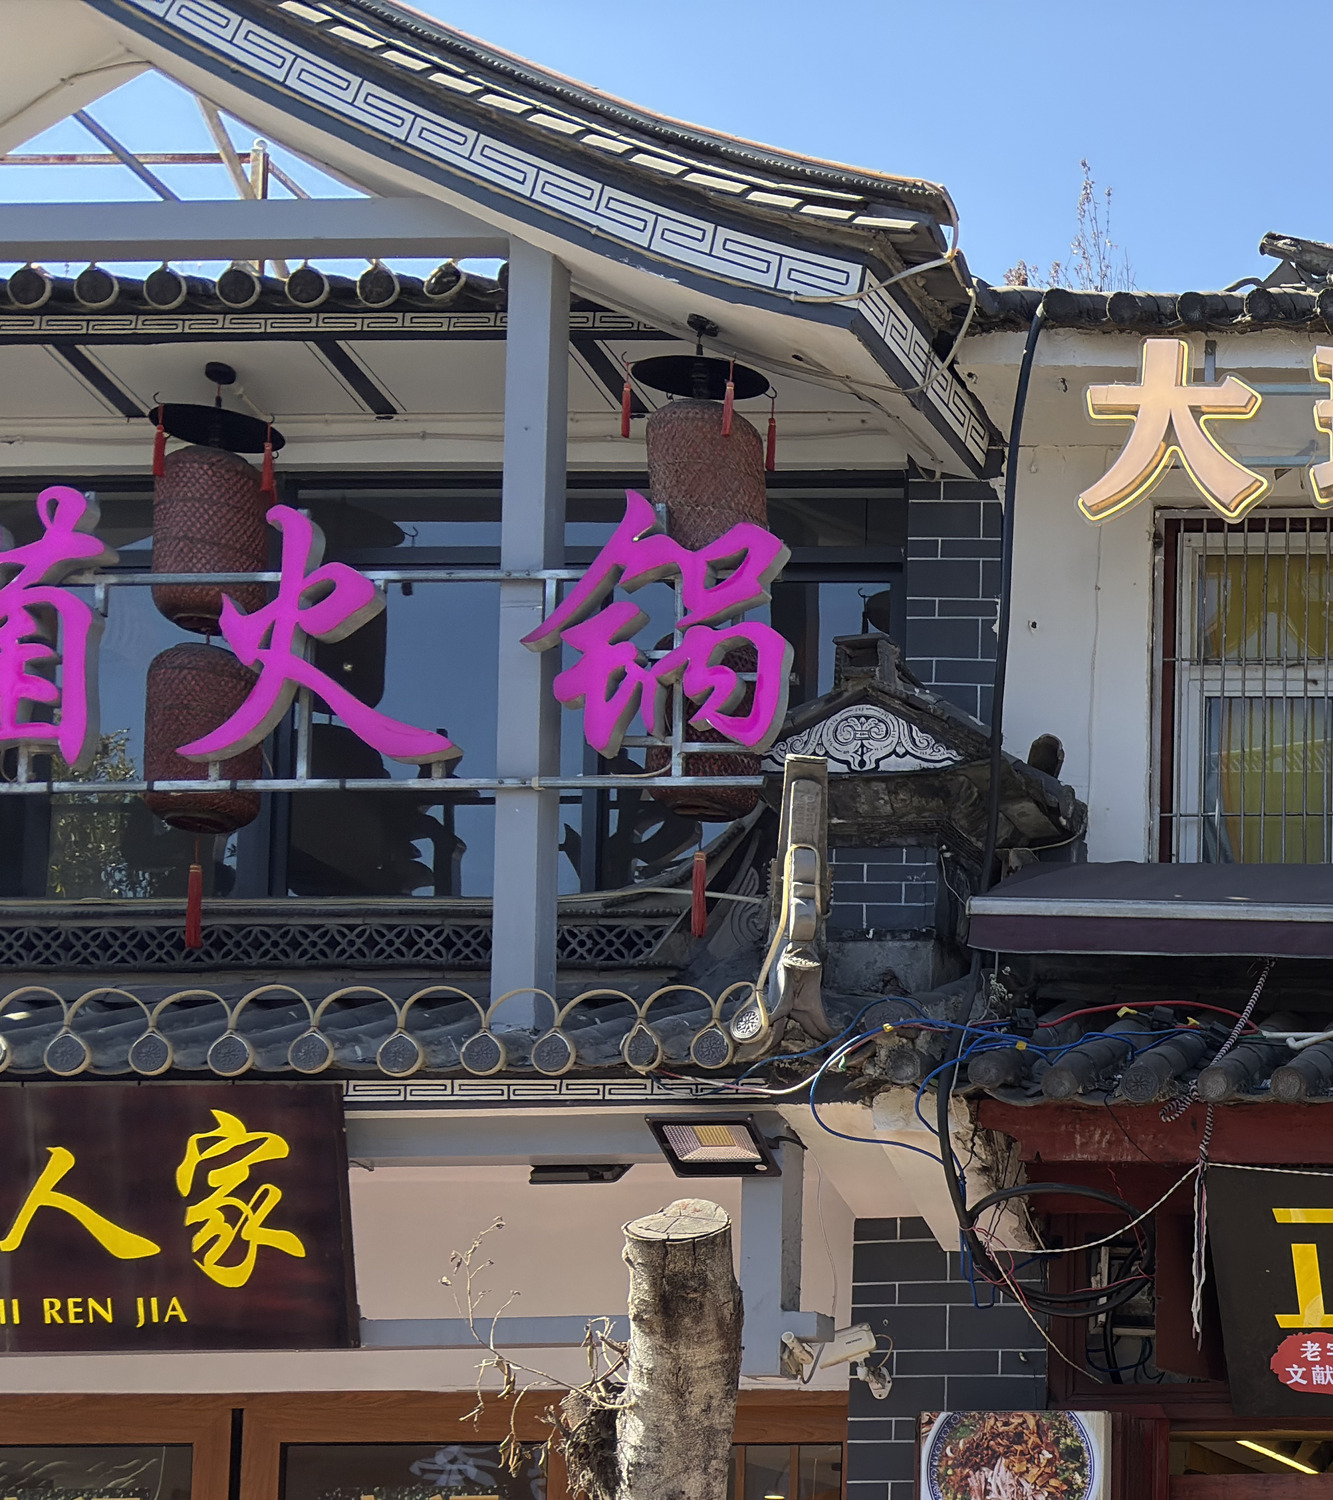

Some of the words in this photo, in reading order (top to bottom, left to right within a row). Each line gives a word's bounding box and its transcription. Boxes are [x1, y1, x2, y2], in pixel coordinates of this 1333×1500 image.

[0, 1109, 306, 1289] 人家
[44, 1298, 114, 1325] REN
[136, 1298, 189, 1329] JIA
